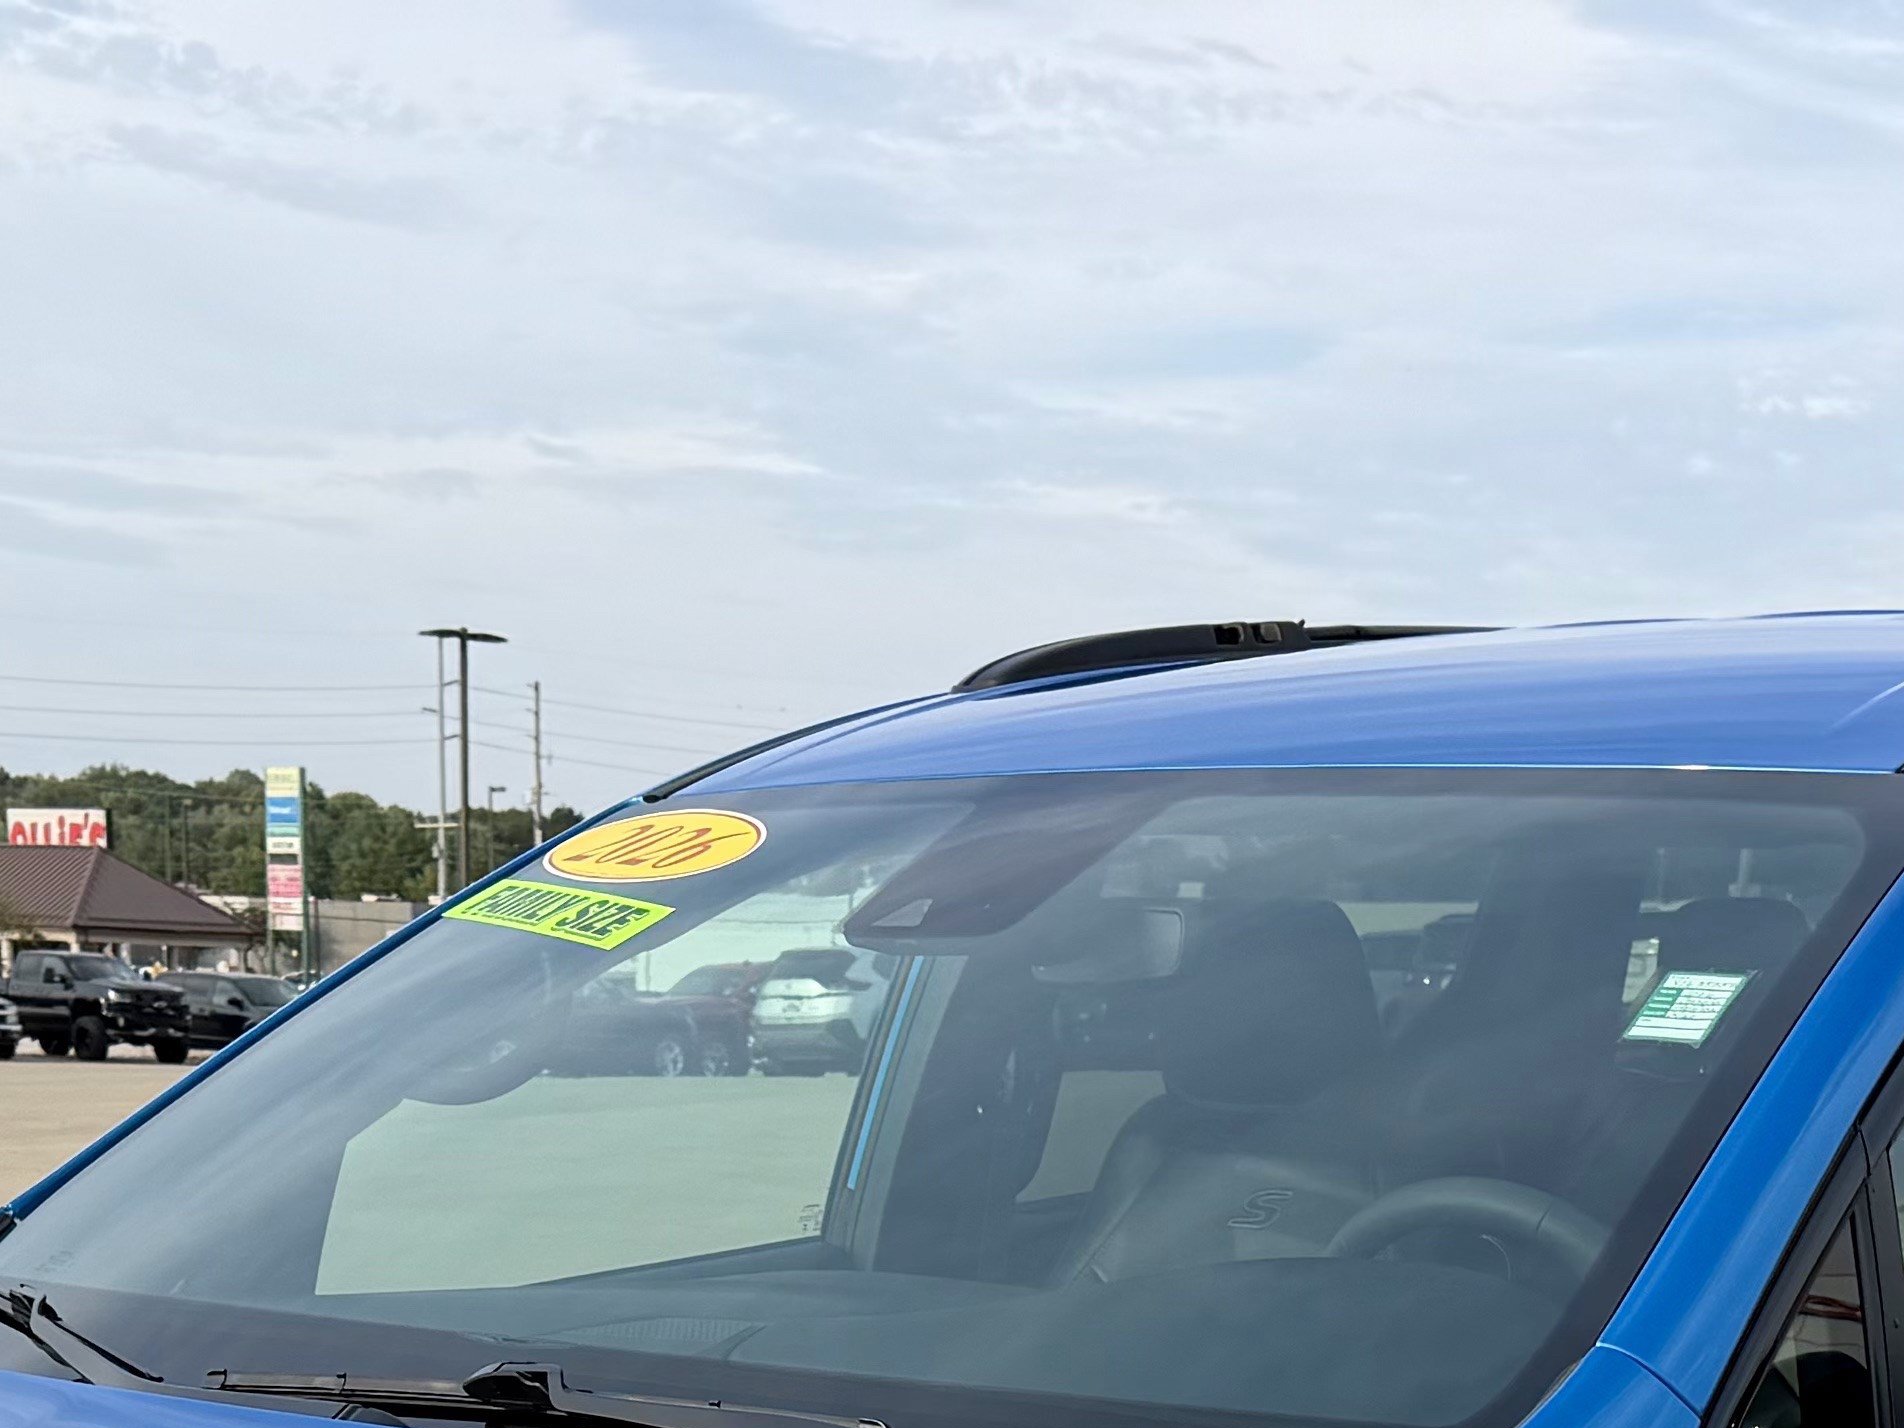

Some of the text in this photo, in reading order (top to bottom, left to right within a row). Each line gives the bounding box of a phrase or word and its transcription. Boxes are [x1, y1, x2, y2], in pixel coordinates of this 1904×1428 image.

[563, 824, 752, 868] 2026
[462, 886, 650, 940] FAMILY SIZE
